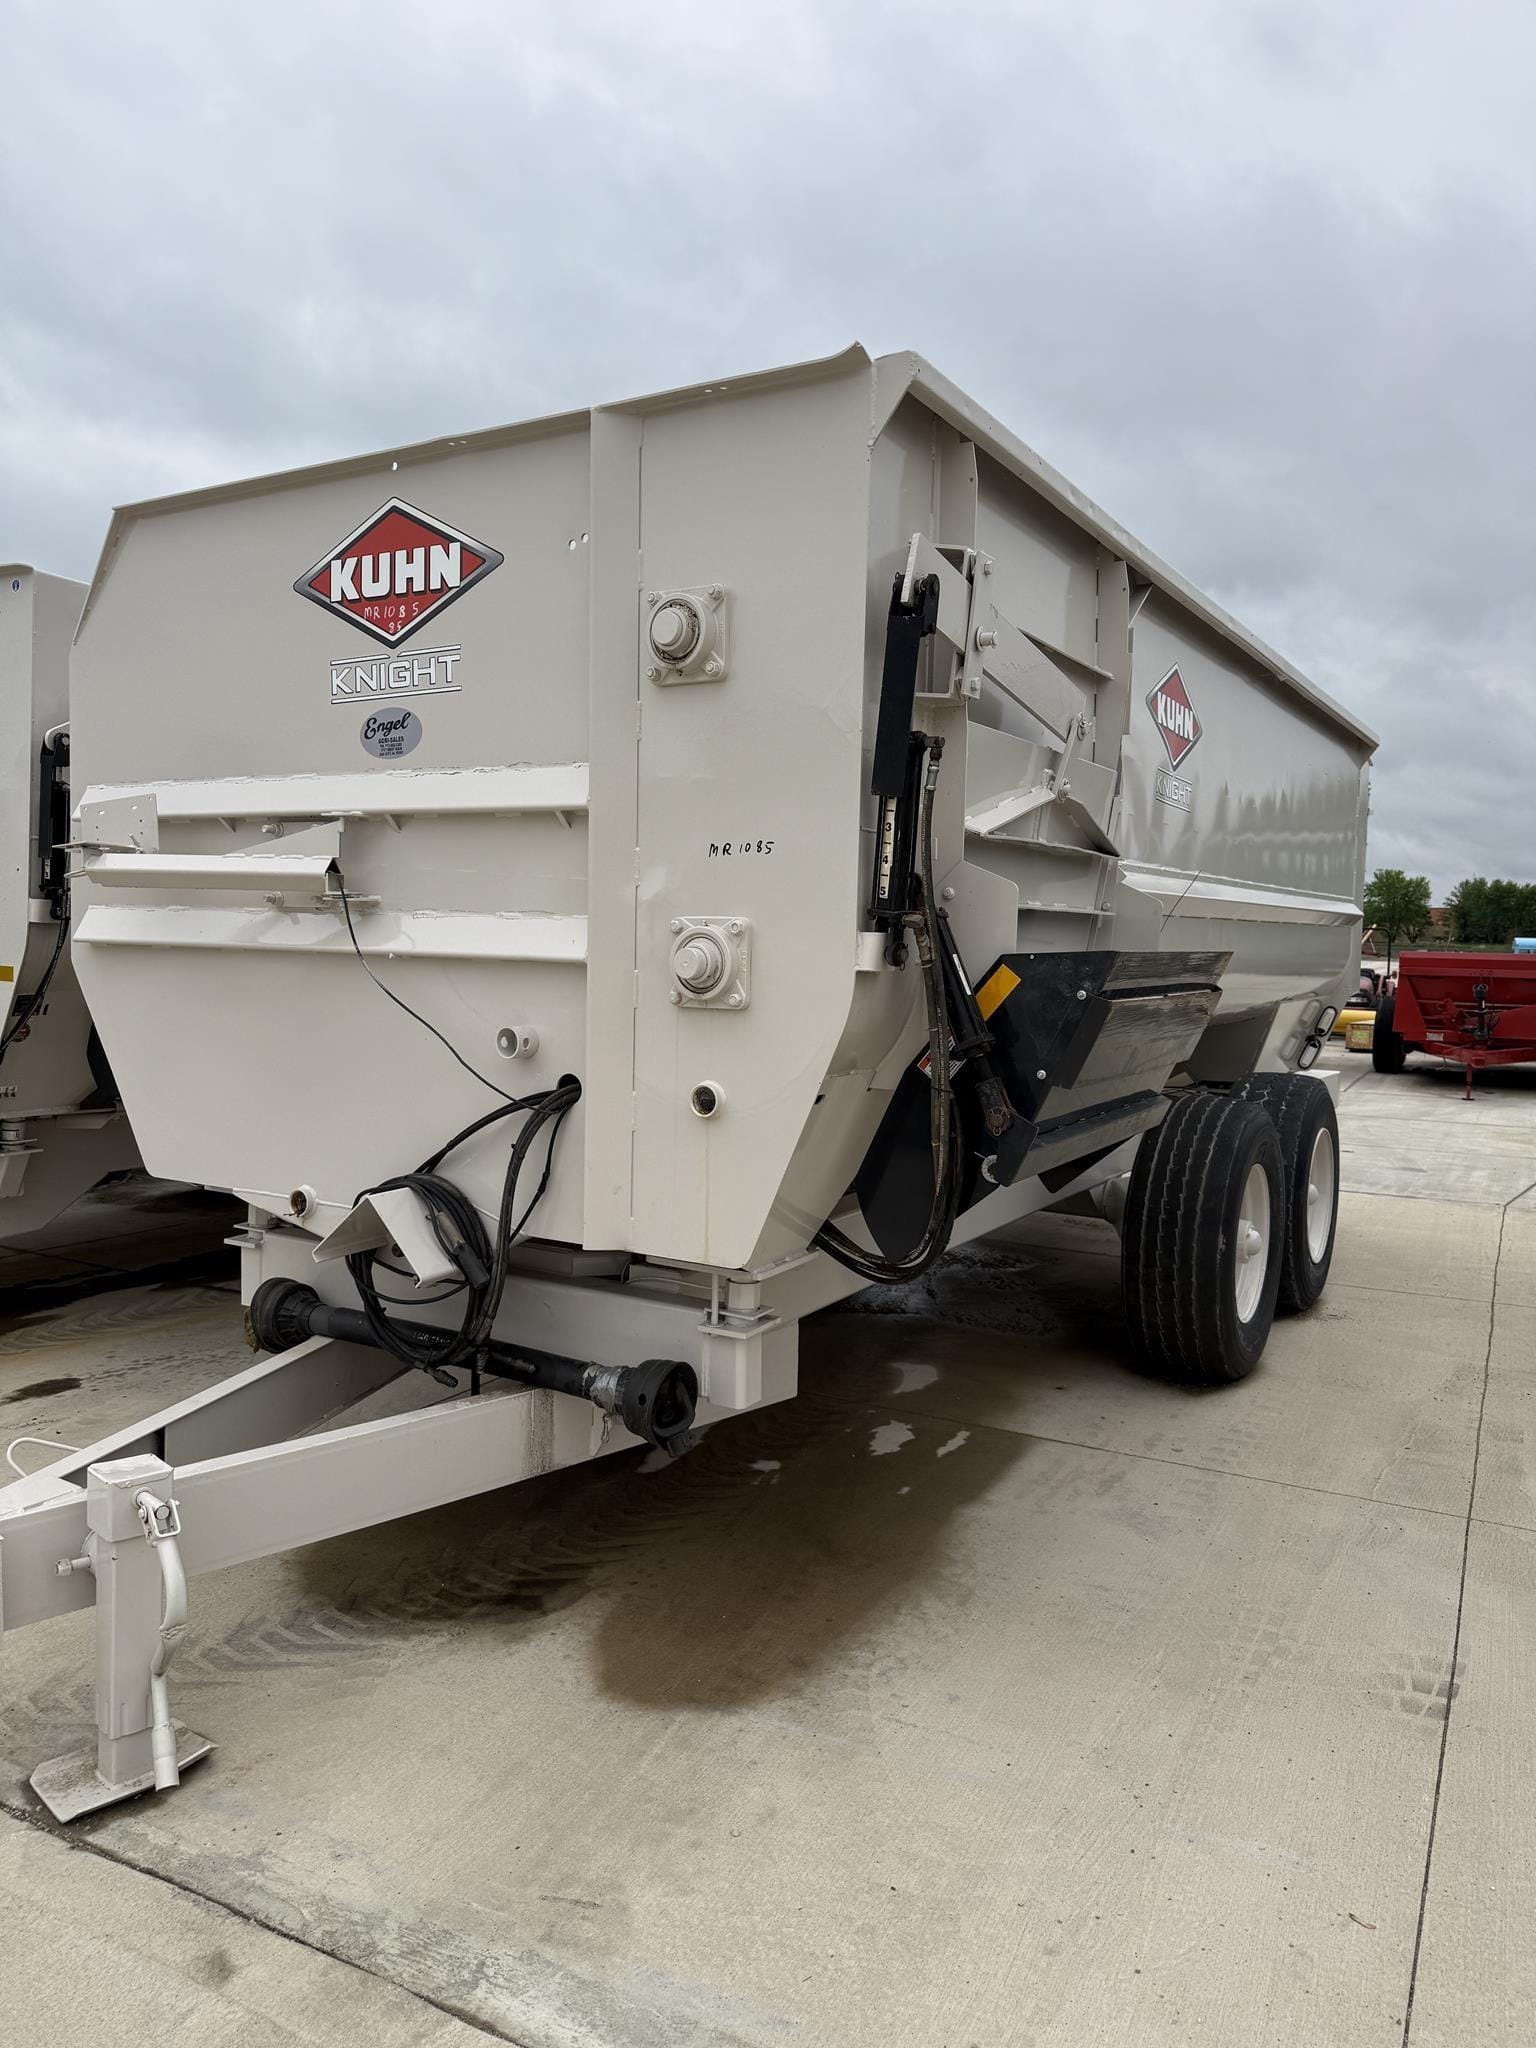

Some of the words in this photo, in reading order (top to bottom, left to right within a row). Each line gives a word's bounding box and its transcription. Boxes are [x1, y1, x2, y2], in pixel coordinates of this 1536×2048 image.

[330, 541, 461, 603] KUHN
[331, 654, 461, 696] KNIGHT
[364, 711, 411, 740] Engel
[1157, 690, 1194, 741] KUHN
[1156, 772, 1192, 807] KNIGHT
[885, 822, 892, 832] 3
[882, 855, 889, 865] 4
[880, 886, 886, 896] 5
